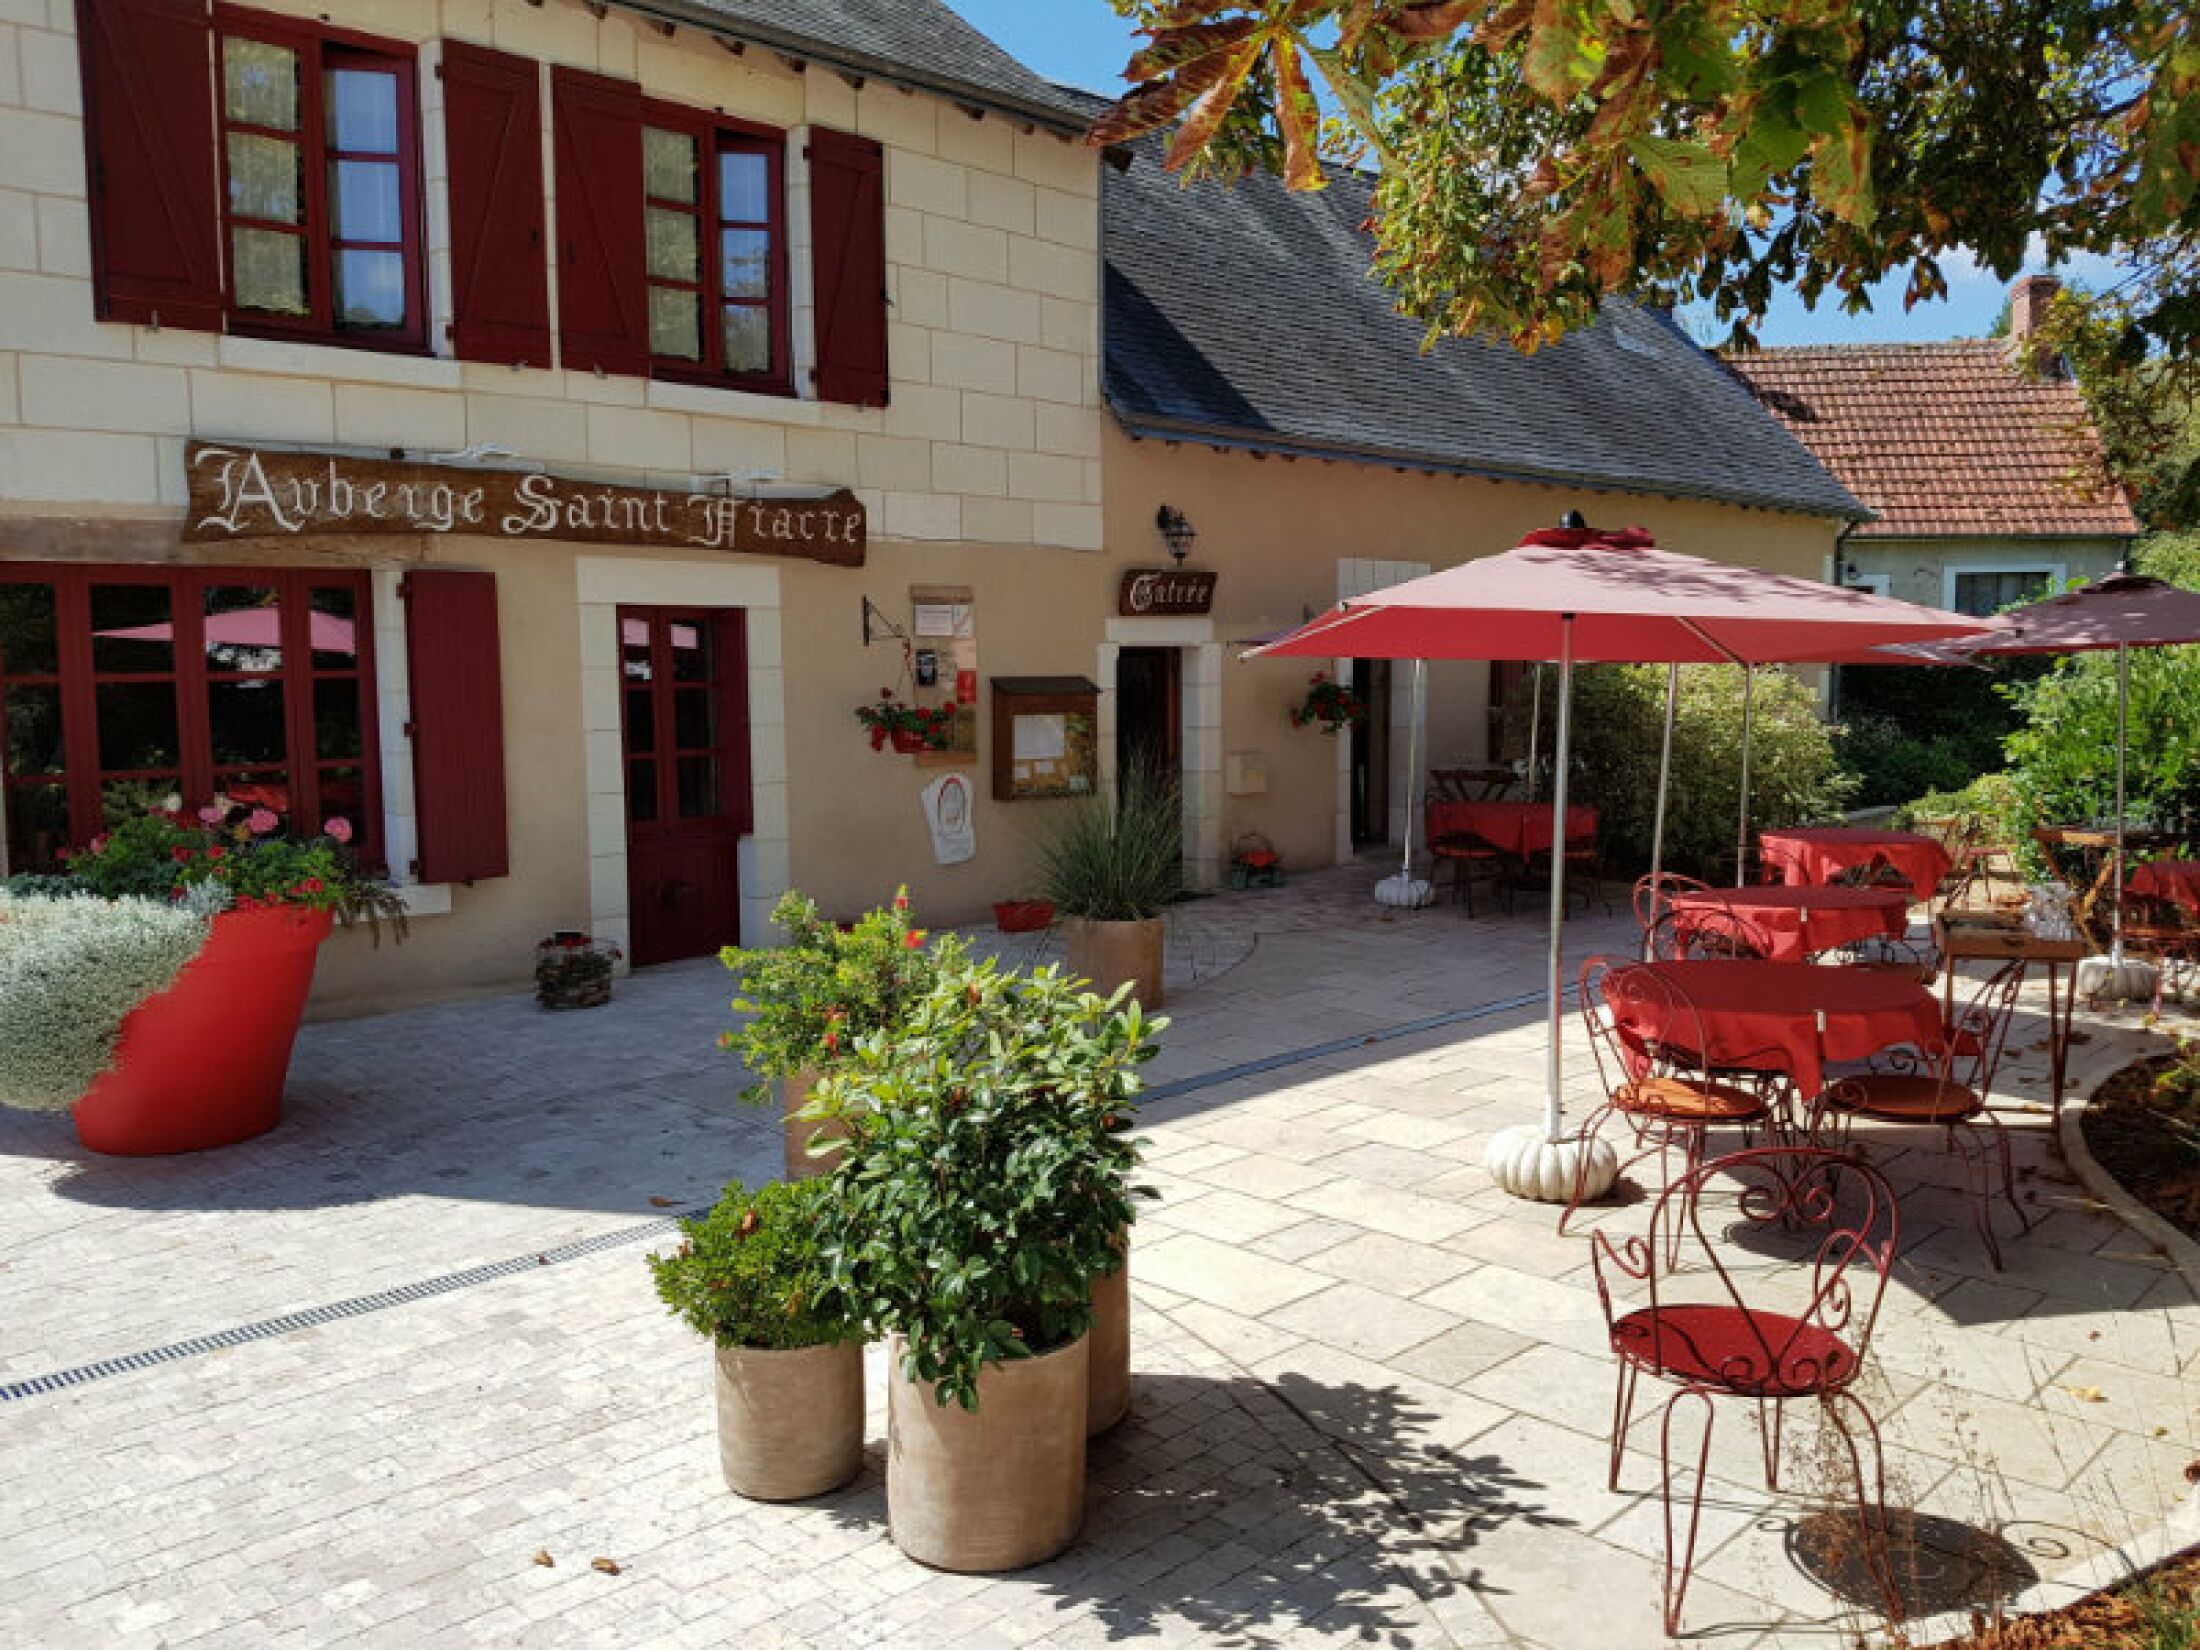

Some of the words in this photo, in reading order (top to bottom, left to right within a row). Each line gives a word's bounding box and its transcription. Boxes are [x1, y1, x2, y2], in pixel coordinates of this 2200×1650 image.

[195, 449, 485, 532] Auberge
[502, 474, 672, 535] Saint
[687, 494, 863, 548] Fiacre
